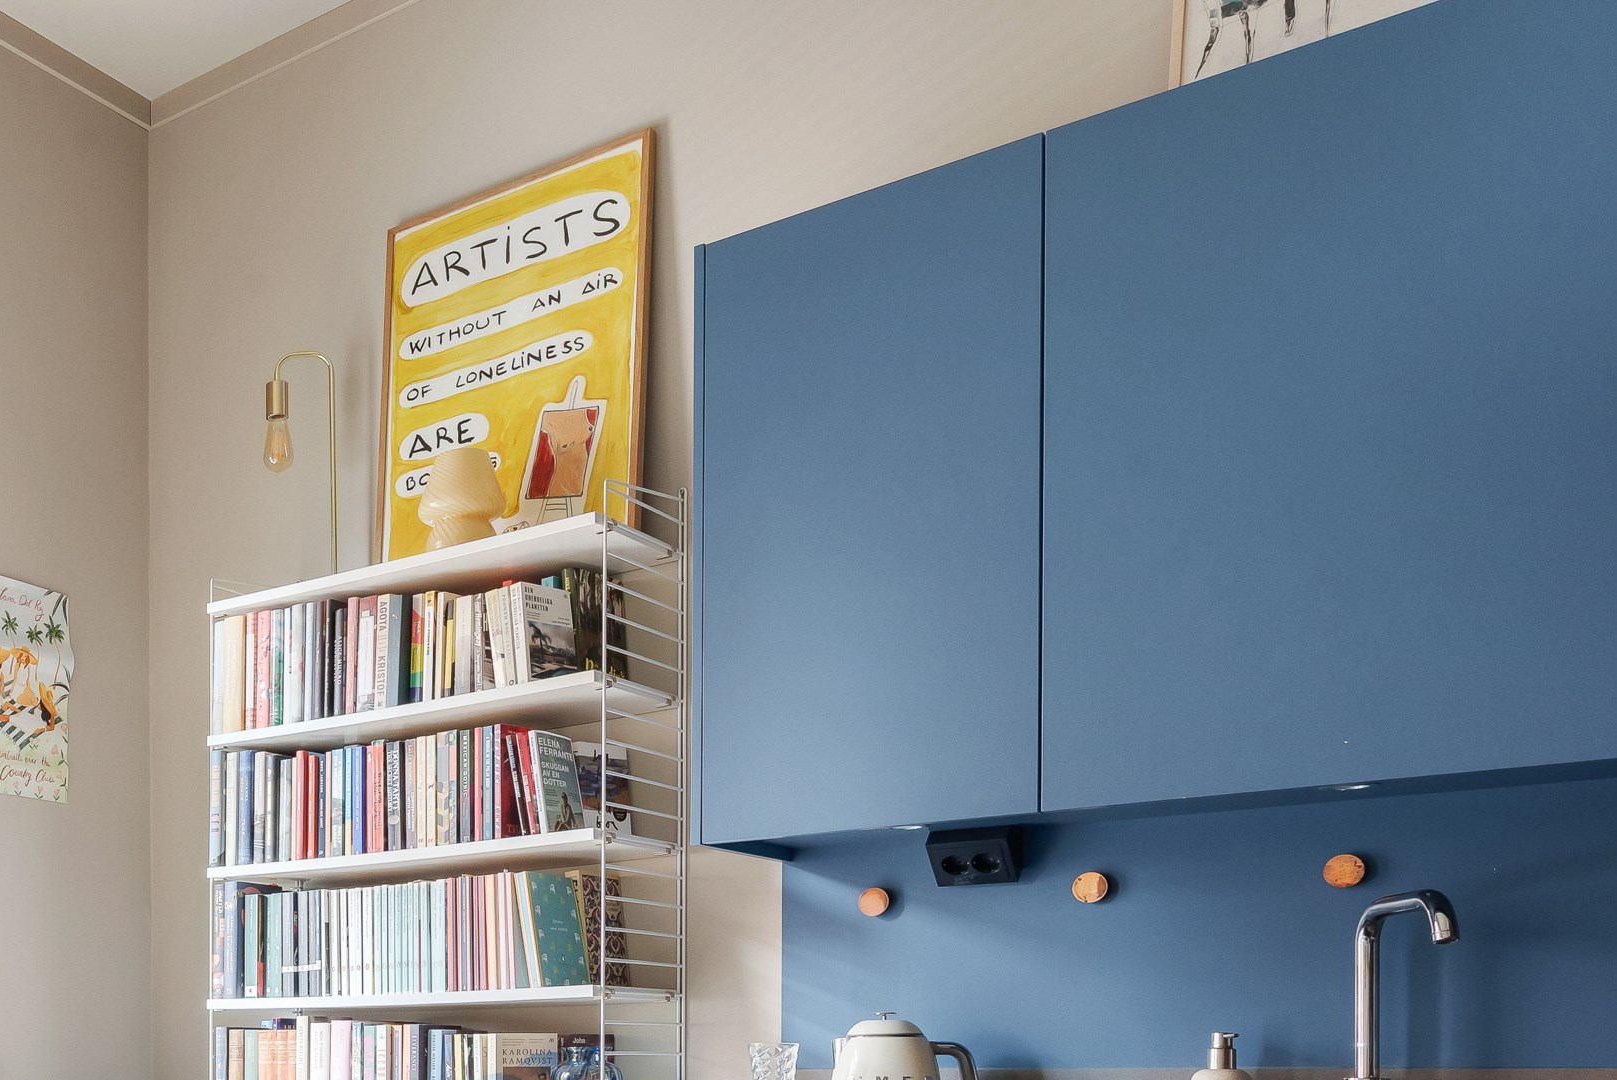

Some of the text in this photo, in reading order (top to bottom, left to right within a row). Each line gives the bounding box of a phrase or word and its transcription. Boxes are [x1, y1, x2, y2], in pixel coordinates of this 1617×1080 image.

[408, 310, 507, 355] WITHOUT
[531, 289, 561, 312] AN
[406, 384, 432, 402] OF
[408, 418, 475, 459] ARE
[377, 601, 388, 697] AGOTA KRISTOF
[537, 737, 561, 749] ELENA
[539, 747, 574, 761] FERRANTE
[541, 762, 570, 773] SKUGGAN
[543, 778, 568, 788] DOTTER
[502, 1048, 553, 1056] KAROLINA
[502, 1057, 553, 1065] RAMQVIST
